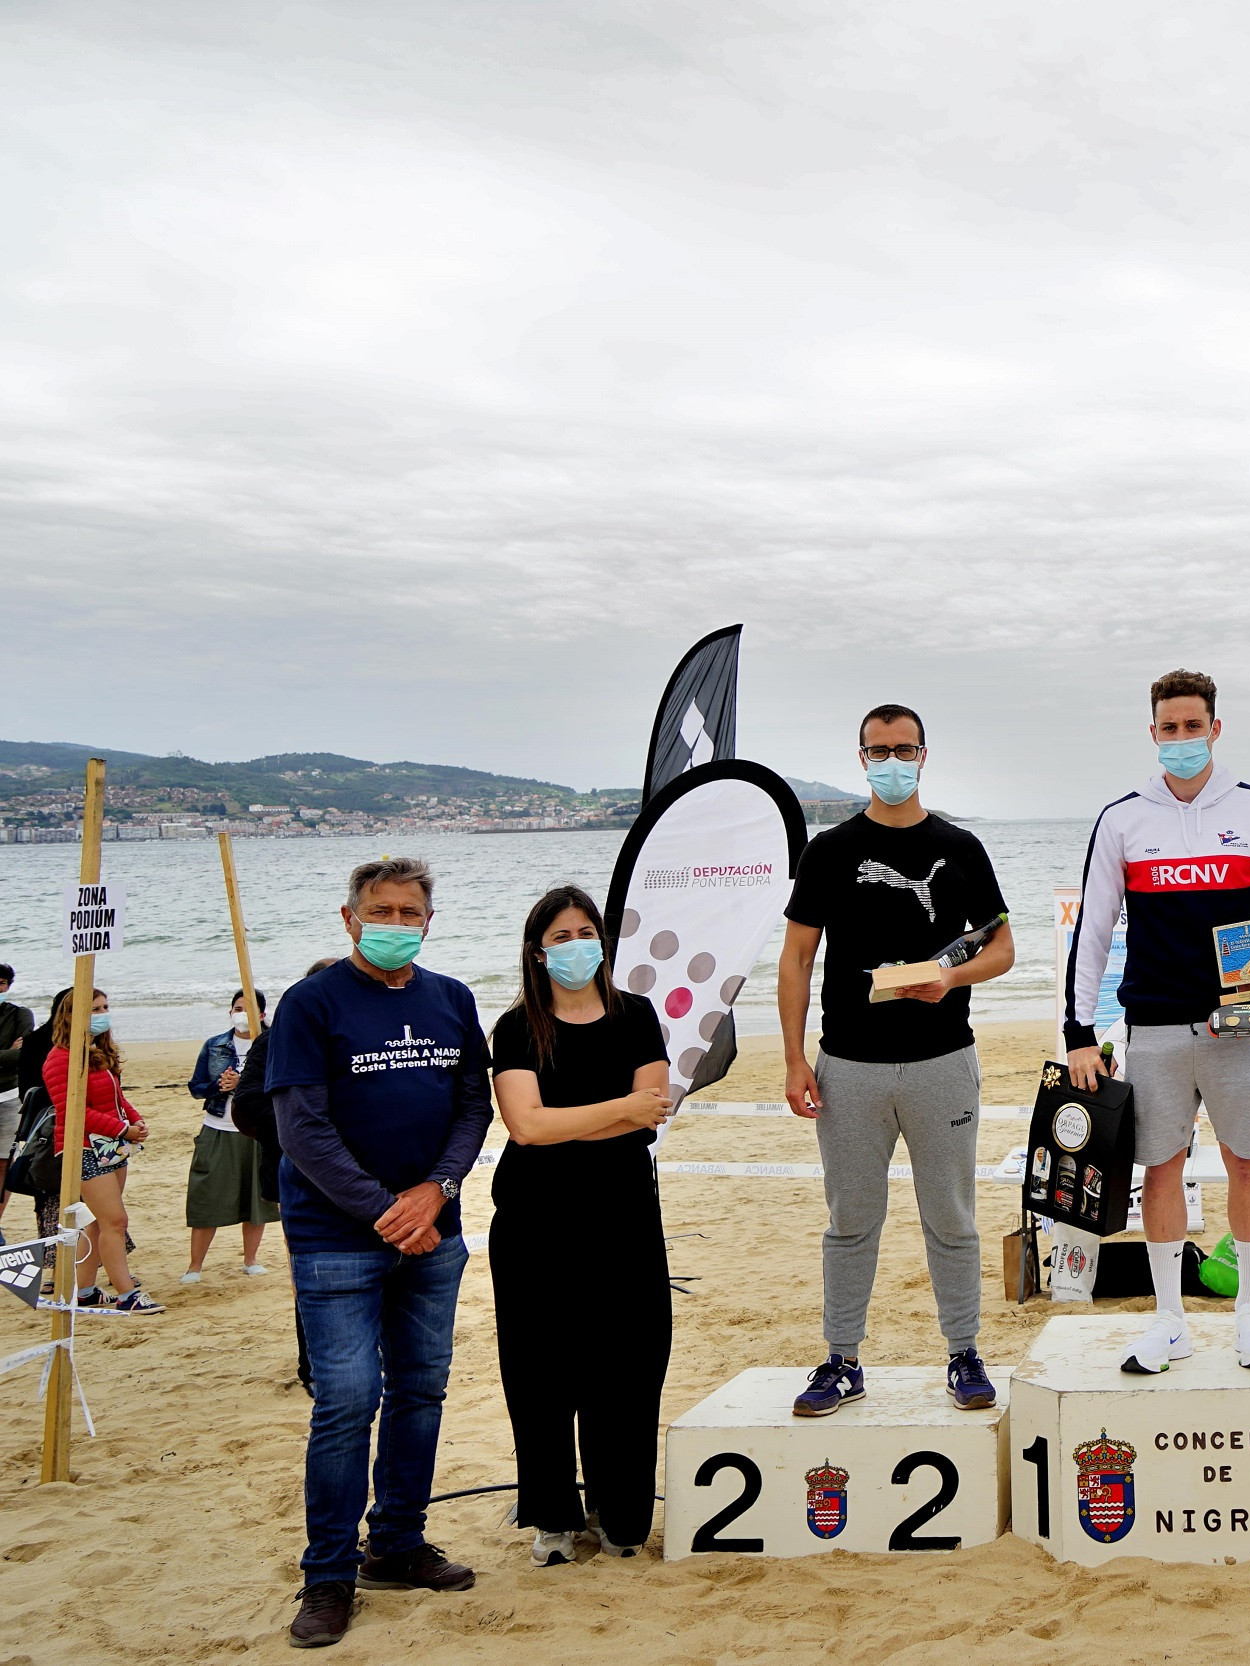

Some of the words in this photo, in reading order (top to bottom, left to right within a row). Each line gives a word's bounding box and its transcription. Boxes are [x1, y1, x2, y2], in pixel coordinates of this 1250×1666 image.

[692, 861, 773, 878] DEPUTACIÓN
[1150, 866, 1160, 886] 1906
[1159, 863, 1230, 885] RCNV
[691, 876, 771, 888] PONTEVEDRA
[77, 886, 107, 907] ZONA
[70, 905, 116, 931] PODIÚM
[72, 930, 111, 954] SALIDA
[351, 1054, 364, 1065] XI
[364, 1047, 420, 1062] TRAVESÍA
[421, 1048, 431, 1058] A
[433, 1047, 461, 1058] NADO
[351, 1062, 387, 1074] Costa
[389, 1060, 428, 1069] Serena
[950, 1115, 972, 1128] PUMA
[1057, 1117, 1087, 1133] ORPAGU
[1058, 1243, 1069, 1274] TROFEOS
[1203, 1465, 1233, 1483] DE
[1022, 1435, 1050, 1539] 1
[690, 1452, 765, 1553] 2
[888, 1450, 962, 1551] 2
